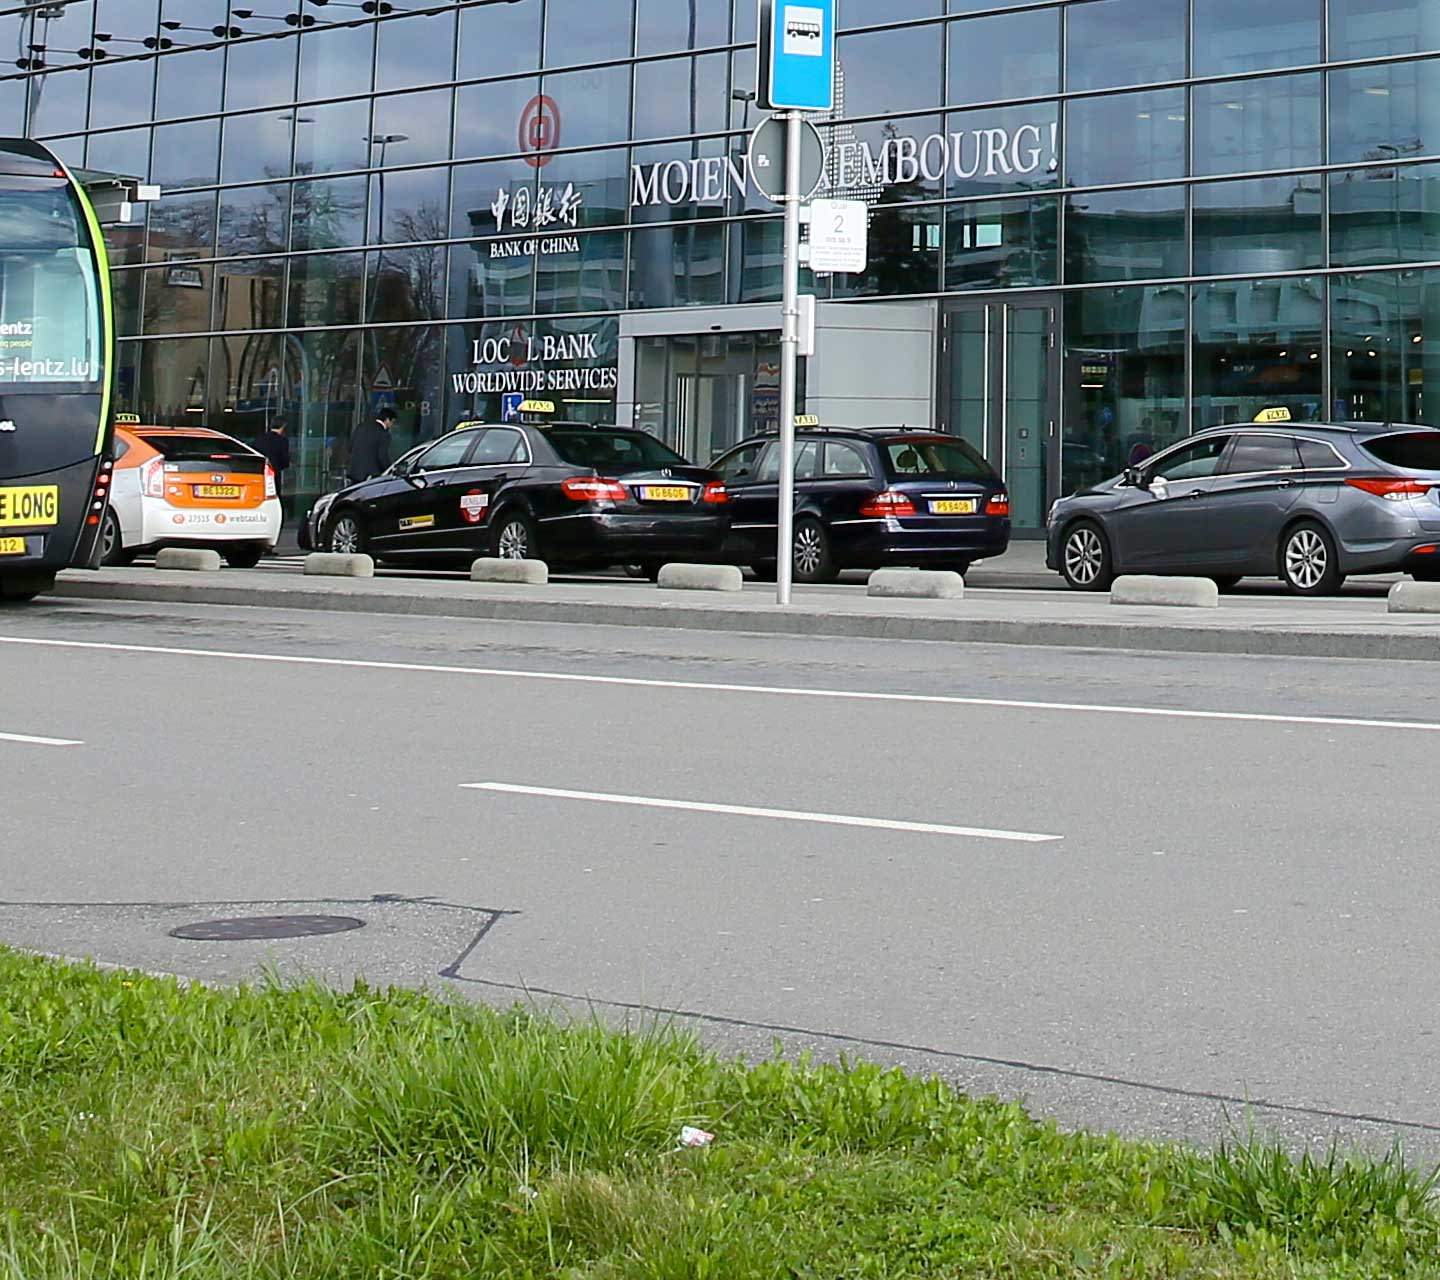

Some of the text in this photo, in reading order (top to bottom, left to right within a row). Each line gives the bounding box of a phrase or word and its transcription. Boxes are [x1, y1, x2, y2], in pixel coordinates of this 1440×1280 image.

[631, 122, 1059, 208] MOIEN XEMBOURG!
[833, 214, 845, 233] 2
[490, 240, 522, 258] BANK
[540, 236, 580, 255] CHINA
[543, 333, 598, 361] BANK
[452, 367, 617, 394] WORLDWIDE SERVICES
[1266, 409, 1288, 420] TAXI
[12, 491, 55, 520] LONG
[229, 513, 267, 523] webtaxi.lu
